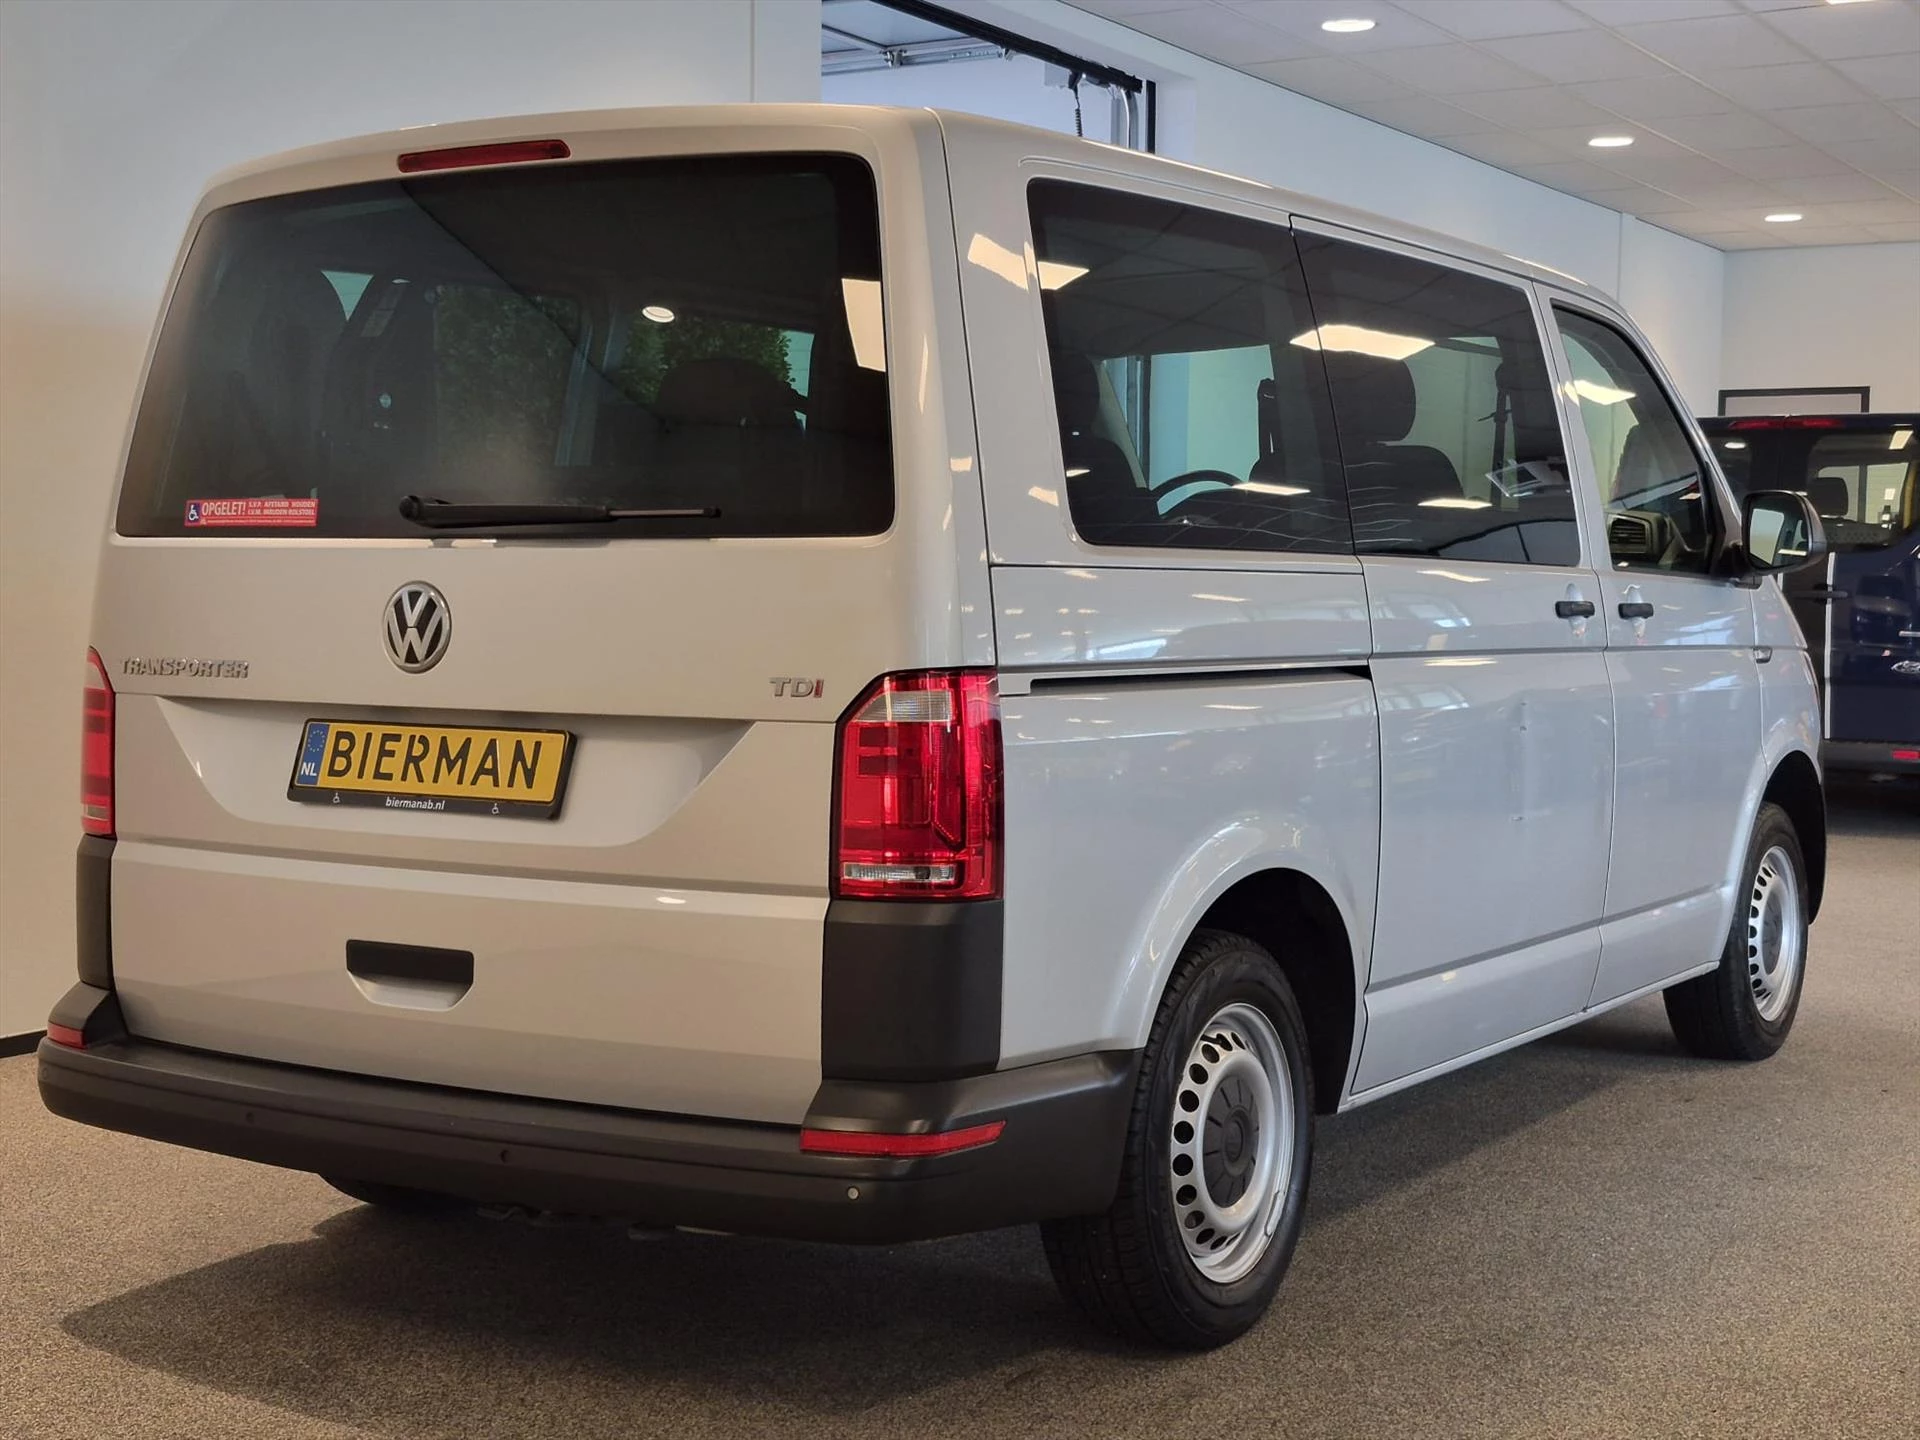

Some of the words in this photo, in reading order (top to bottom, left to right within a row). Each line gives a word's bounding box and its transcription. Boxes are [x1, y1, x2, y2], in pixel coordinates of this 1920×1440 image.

[201, 501, 247, 516] OPGELET!
[122, 658, 249, 679] TRANSPORTER
[768, 677, 825, 699] TDI
[326, 729, 543, 789] BIERMAN
[300, 761, 318, 777] NL
[385, 795, 446, 811] biermanab.nl
